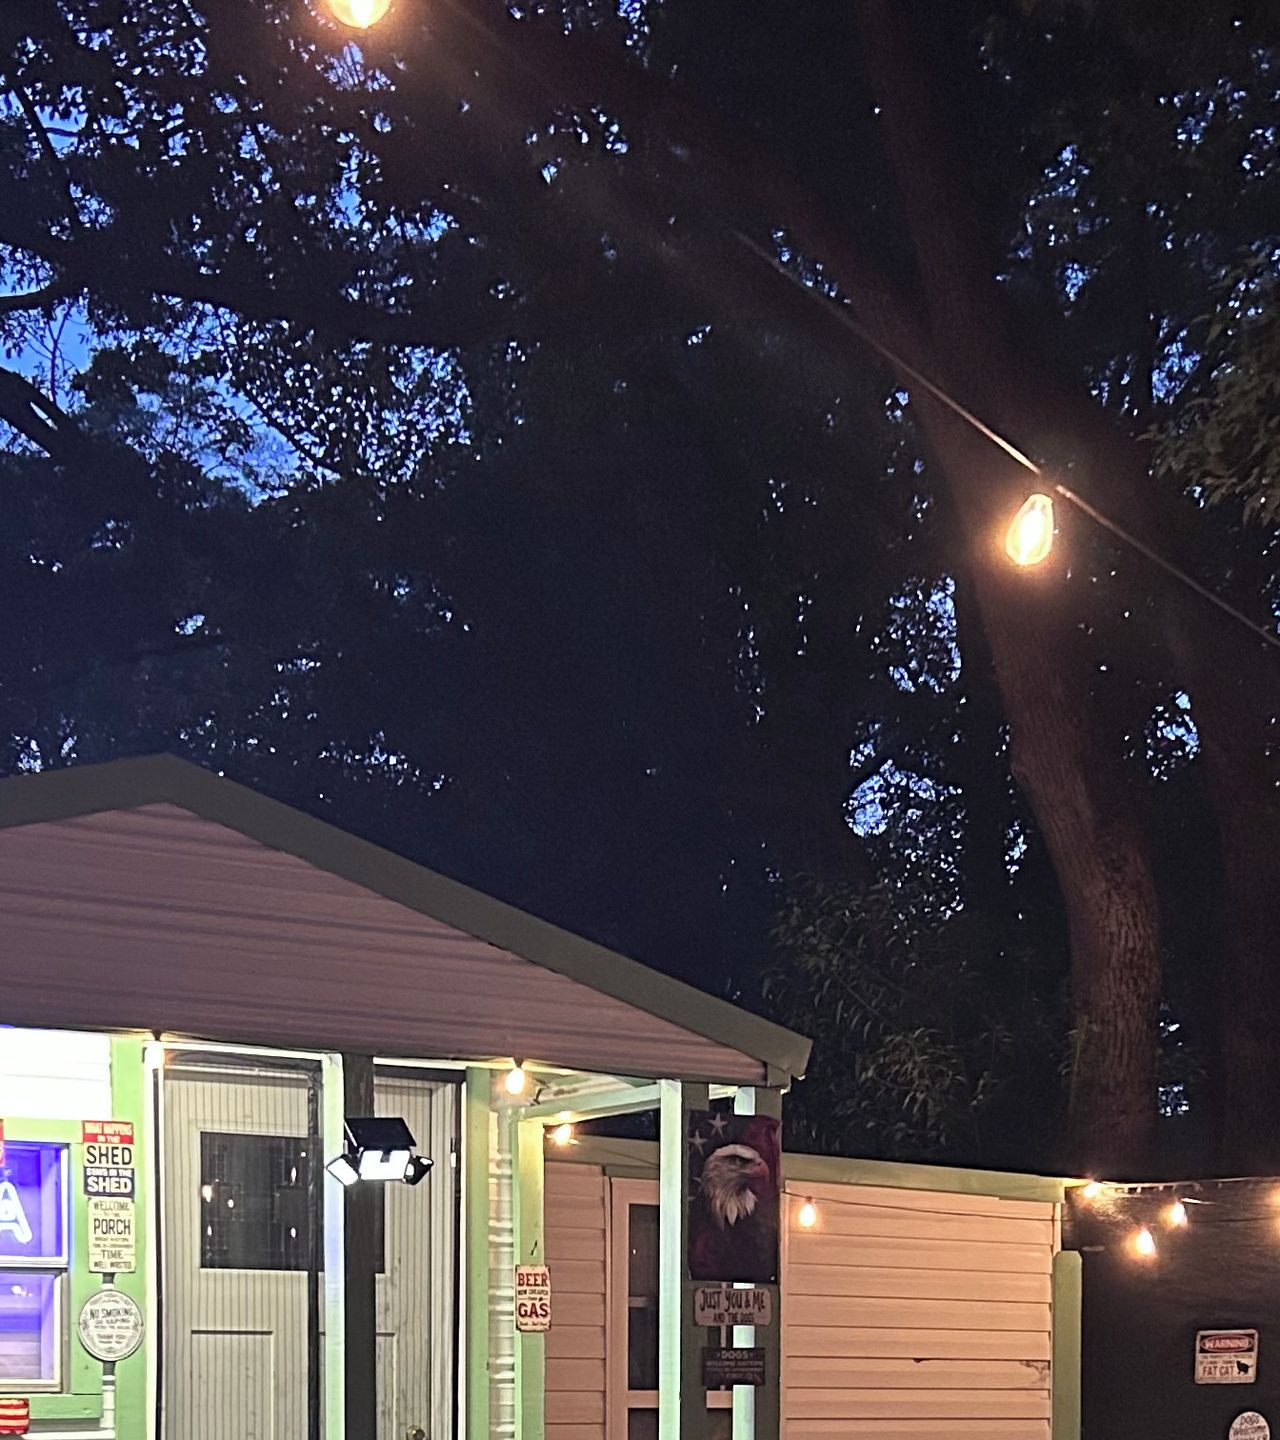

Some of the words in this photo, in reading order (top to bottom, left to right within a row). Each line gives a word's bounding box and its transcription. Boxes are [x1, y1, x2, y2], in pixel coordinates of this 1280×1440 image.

[86, 1145, 132, 1165] SHED
[87, 1176, 132, 1193] SHED
[94, 1200, 129, 1211] WELCOME
[94, 1218, 131, 1235] PORCH
[101, 1250, 123, 1259] TIME
[518, 1273, 548, 1287] BEER
[700, 1290, 721, 1311] JUST
[724, 1291, 742, 1312] YOU
[744, 1291, 751, 1309] &
[753, 1291, 765, 1312] ME
[90, 1309, 99, 1319] NO
[101, 1308, 132, 1318] SMOKING
[518, 1303, 548, 1318] GAS
[713, 1313, 725, 1323] AND
[728, 1313, 738, 1323] THE
[1205, 1339, 1249, 1348] WARNING
[721, 1350, 748, 1359] DOGS
[1203, 1366, 1218, 1376] FAT
[1219, 1366, 1234, 1376] CAT
